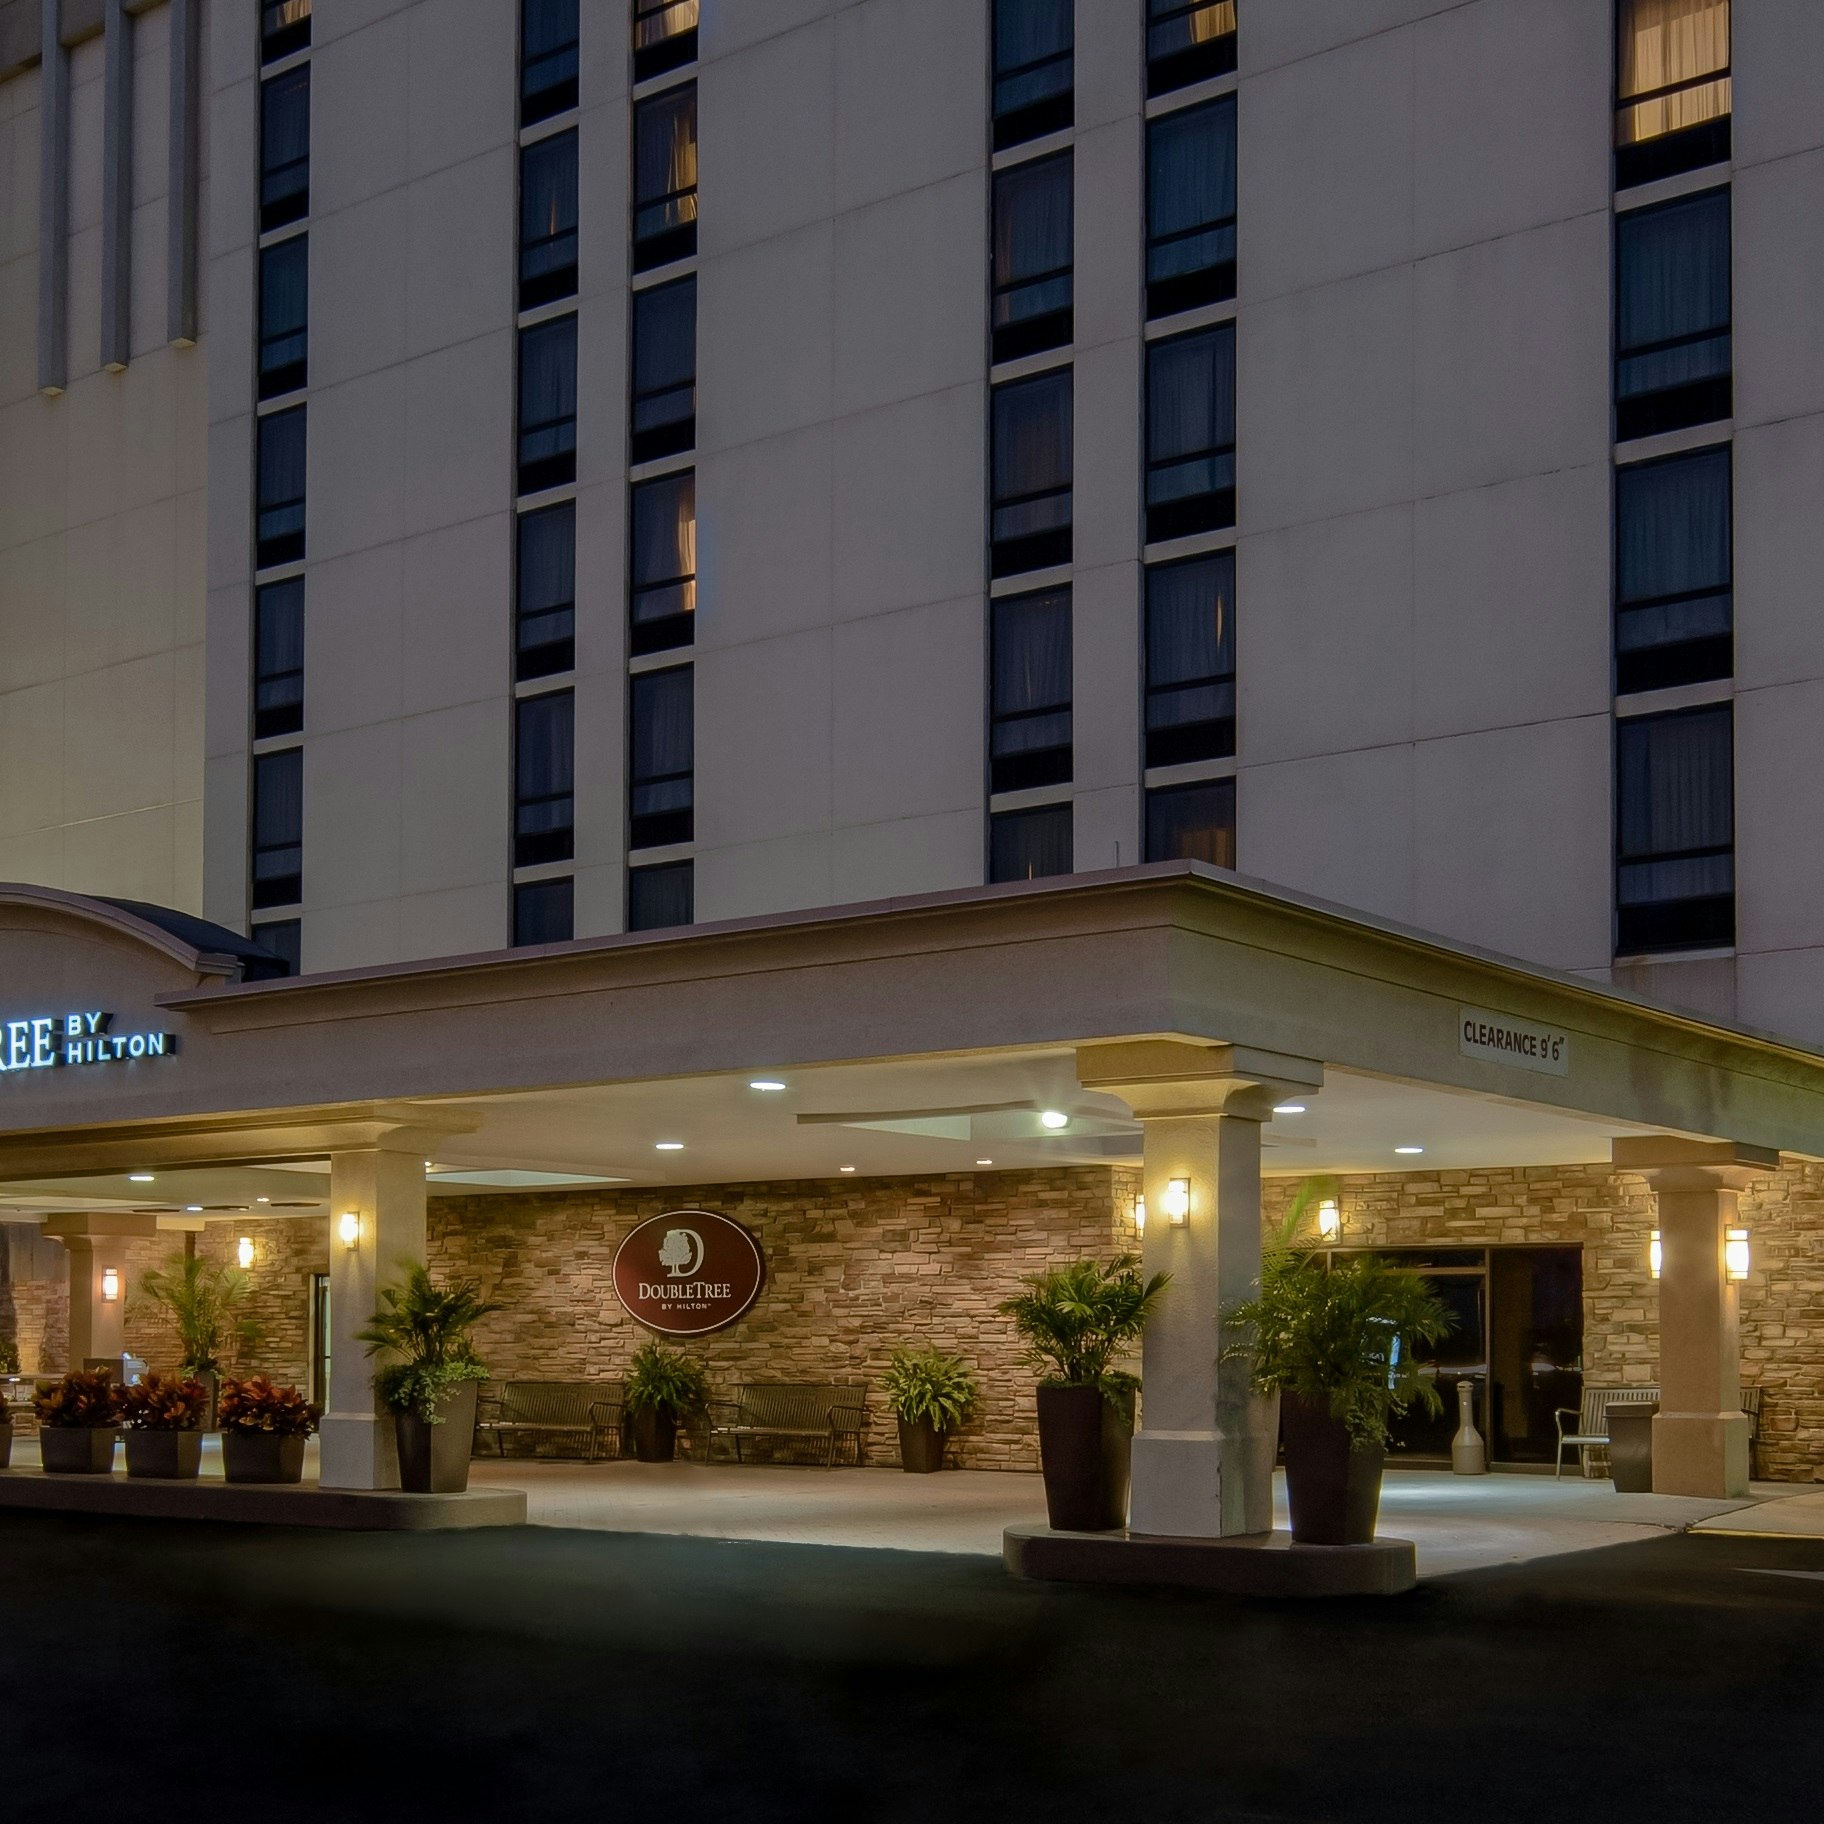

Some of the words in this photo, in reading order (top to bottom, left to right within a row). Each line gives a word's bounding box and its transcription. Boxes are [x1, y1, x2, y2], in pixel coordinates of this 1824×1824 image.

[67, 1012, 102, 1037] BY
[1463, 1020, 1537, 1057] CLEARANCE
[66, 1032, 165, 1065] HILTON
[638, 1281, 732, 1300] DOUBLETREE
